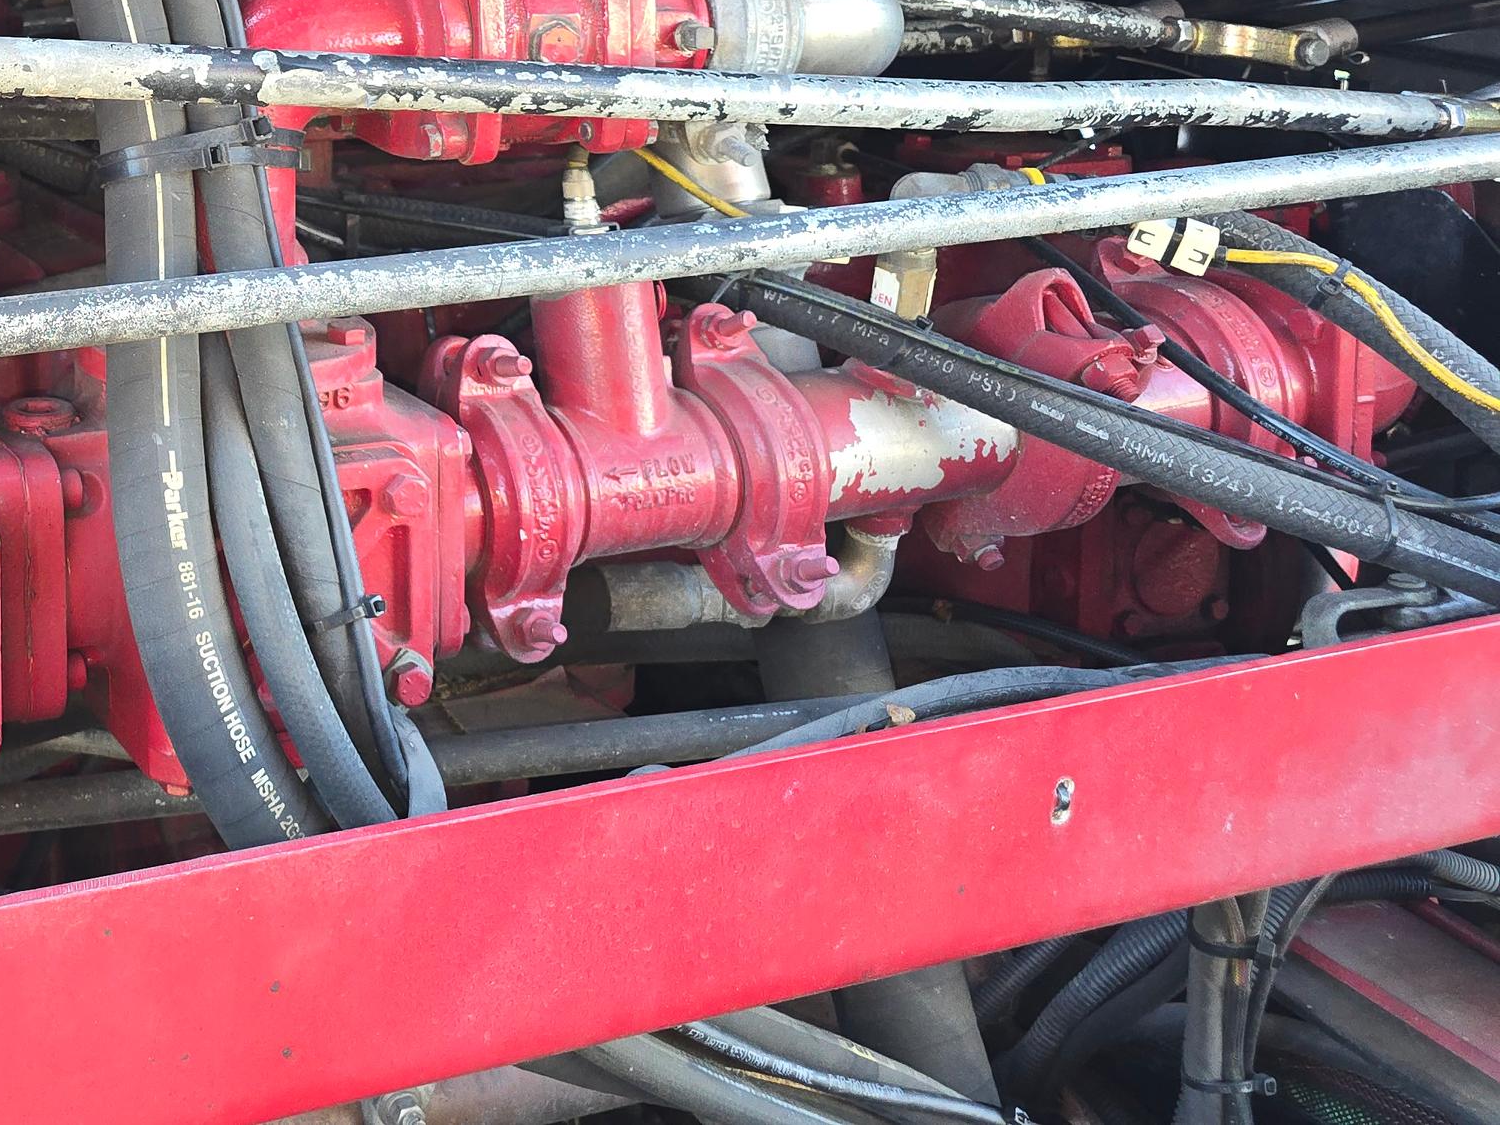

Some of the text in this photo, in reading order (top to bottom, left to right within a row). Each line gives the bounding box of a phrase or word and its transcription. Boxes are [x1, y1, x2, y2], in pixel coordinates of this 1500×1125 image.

[161, 450, 189, 552] Parker
[177, 560, 205, 620] 881-16
[194, 630, 236, 715] SUCTION
[221, 709, 258, 765] HOSE
[250, 767, 286, 820] MSHA
